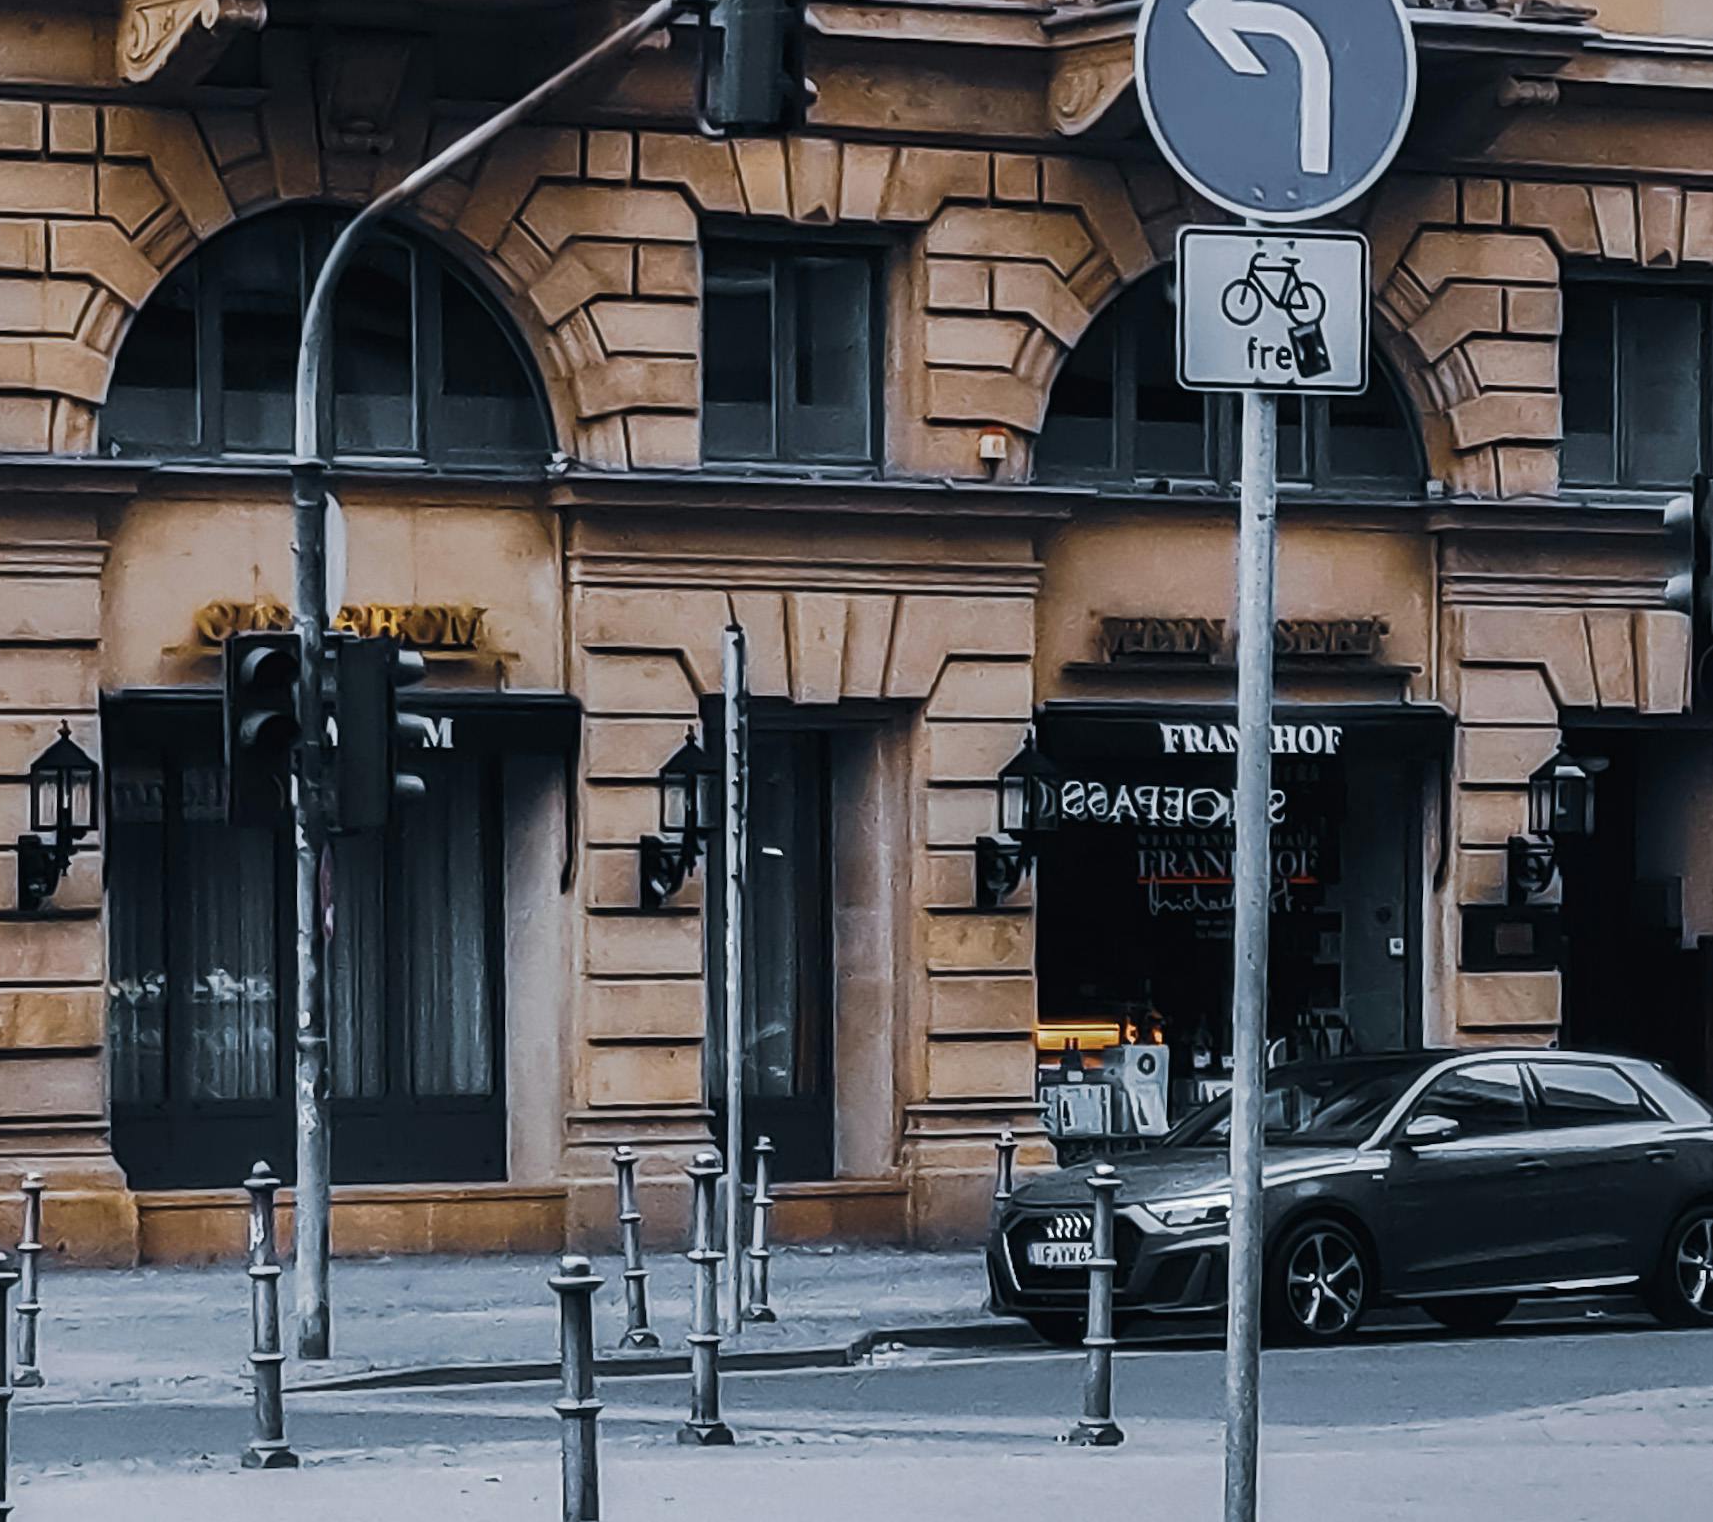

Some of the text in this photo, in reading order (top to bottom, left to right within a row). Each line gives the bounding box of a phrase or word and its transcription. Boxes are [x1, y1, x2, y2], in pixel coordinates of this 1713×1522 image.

[1247, 336, 1294, 371] fre
[1160, 723, 1344, 754] FRANHOF
[1138, 850, 1319, 877] FRANOF
